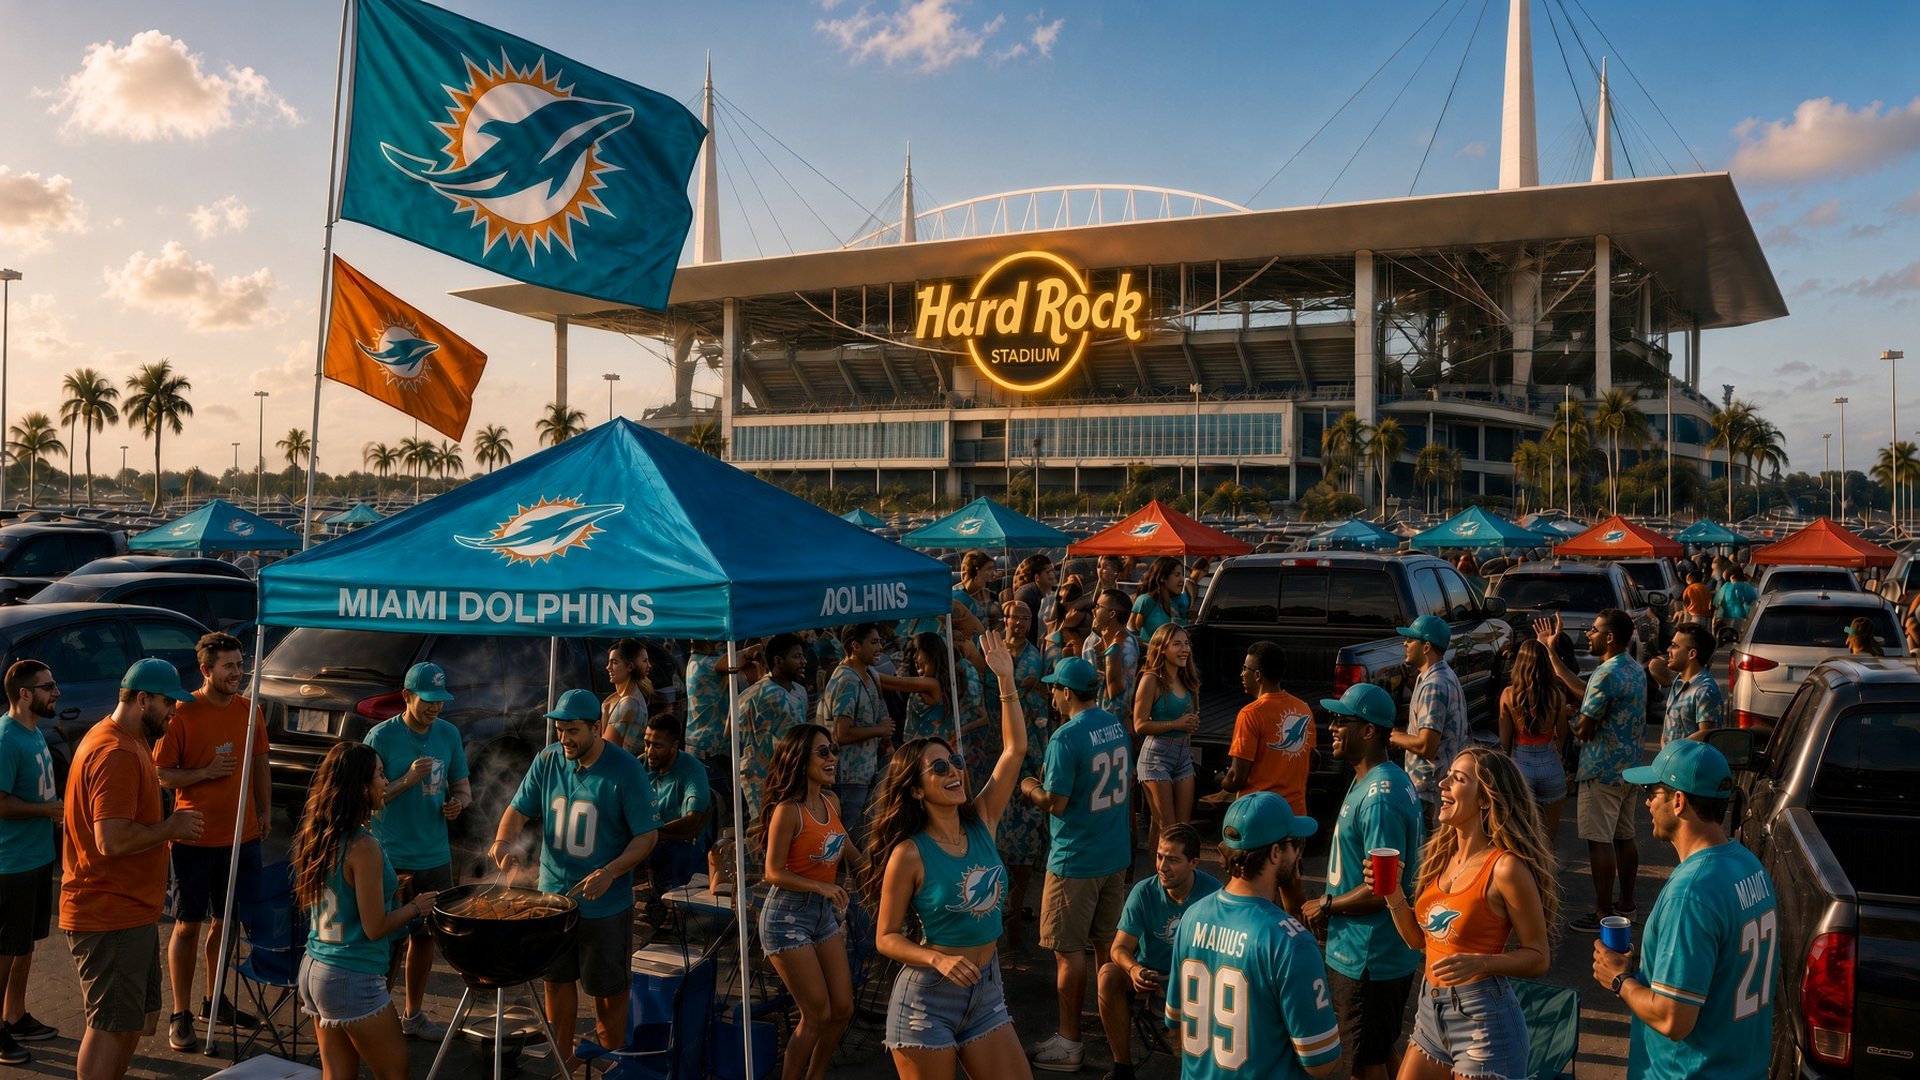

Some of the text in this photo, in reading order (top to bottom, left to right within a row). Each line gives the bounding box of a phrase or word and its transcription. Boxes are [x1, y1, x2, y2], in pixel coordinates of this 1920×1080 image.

[916, 273, 1142, 345] Hard Rock
[991, 347, 1060, 364] STADIUM
[338, 587, 655, 627] MIAMI DOLPHINS
[1090, 745, 1129, 813] 23
[551, 795, 599, 858] 10
[1311, 977, 1330, 1011] 2
[1734, 909, 1777, 1021] 27
[1180, 958, 1249, 1071] 99
